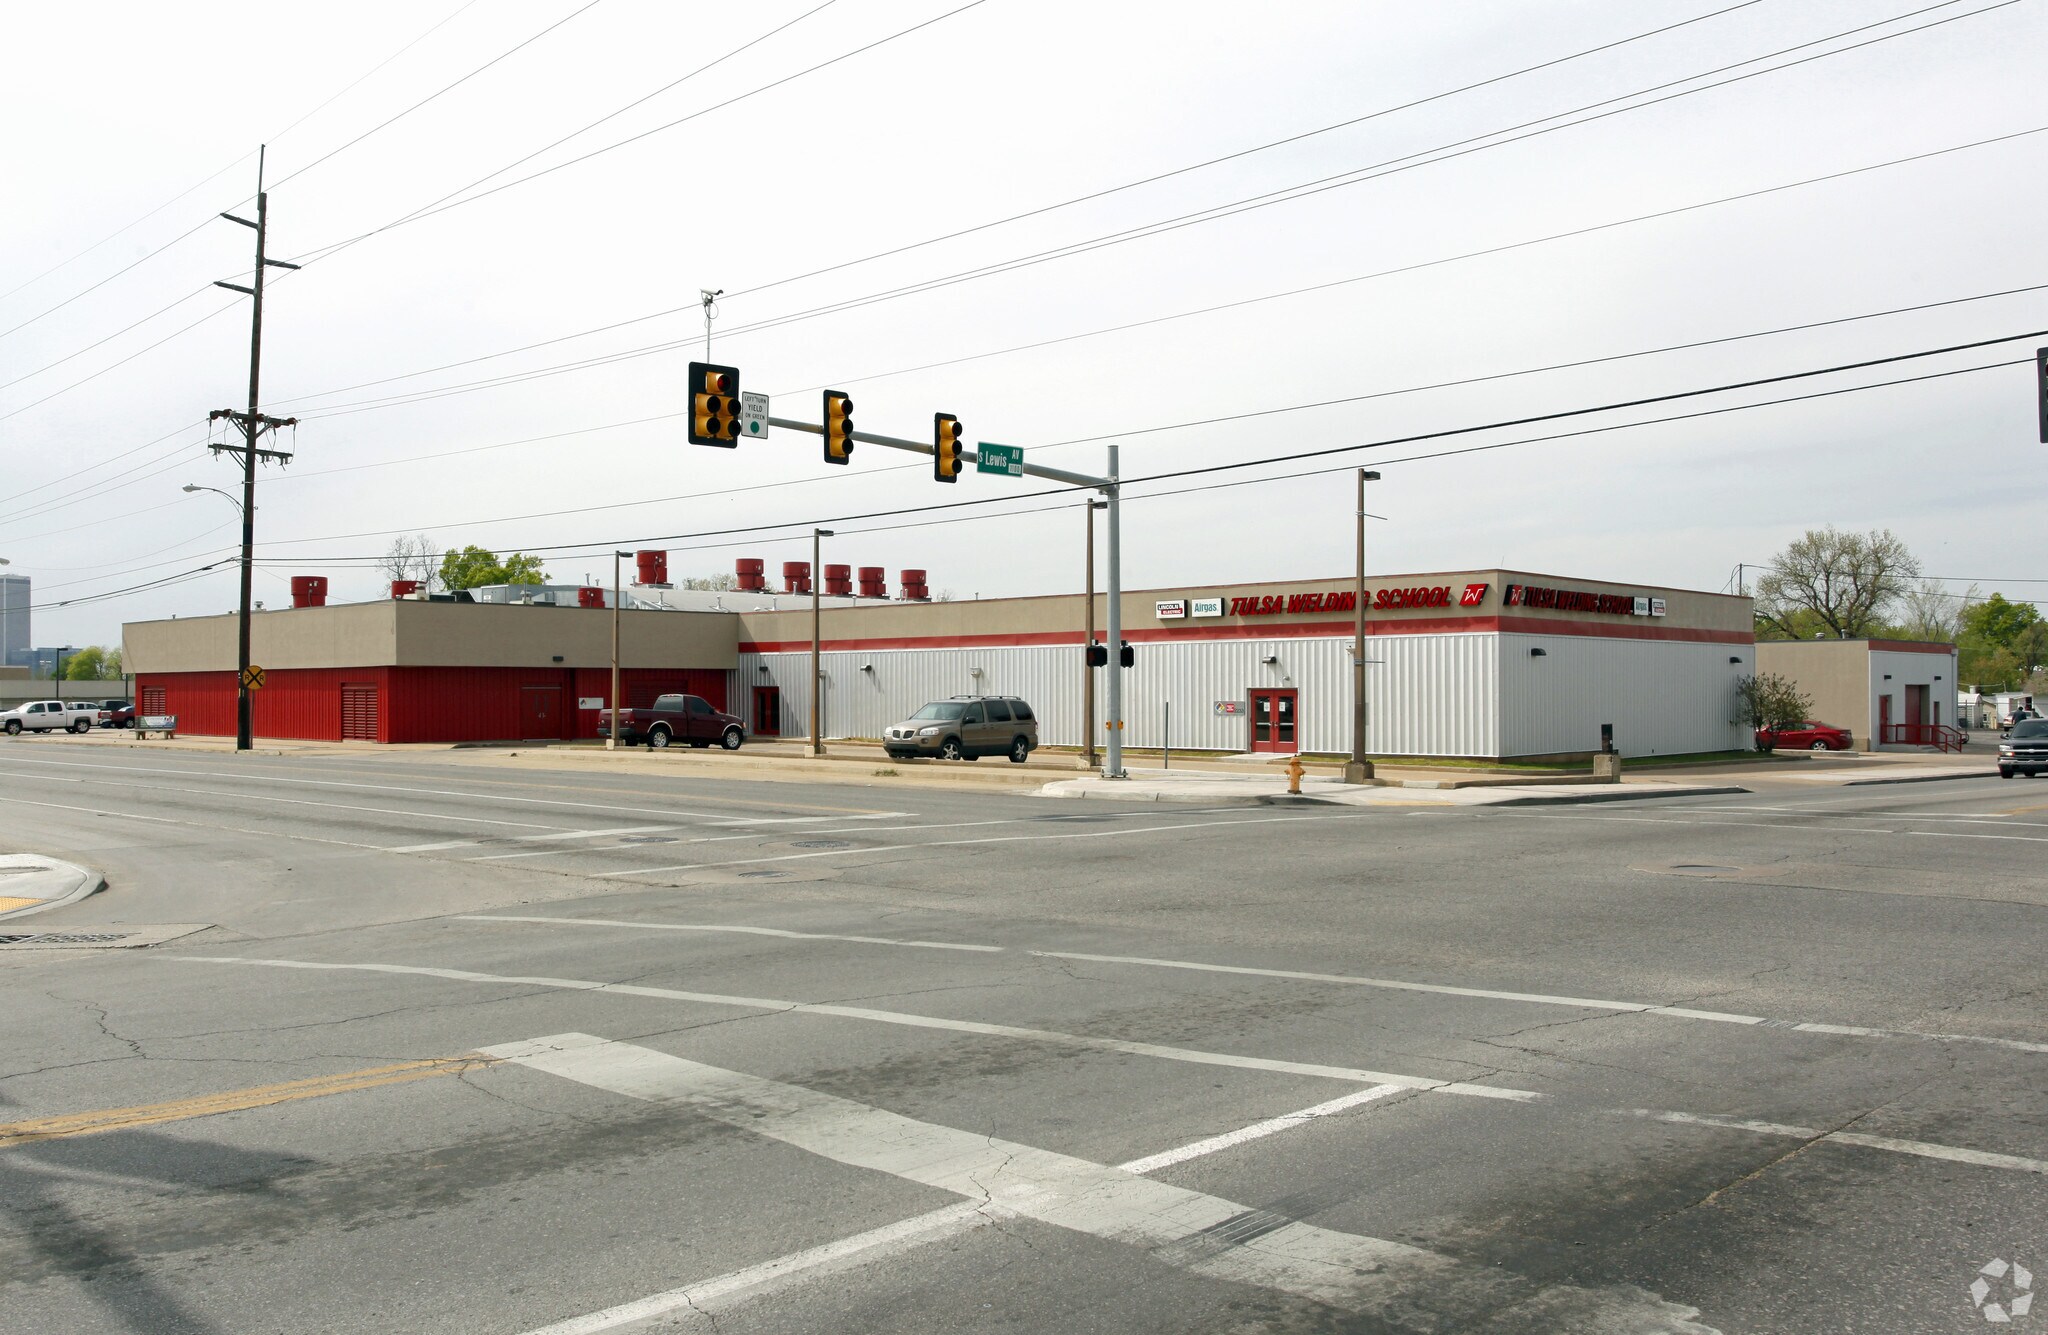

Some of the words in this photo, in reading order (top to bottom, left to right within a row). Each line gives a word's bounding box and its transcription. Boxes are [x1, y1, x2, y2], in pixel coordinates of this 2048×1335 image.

[748, 404, 762, 412] YIELD
[979, 452, 983, 462] S
[985, 451, 1007, 467] Lewis
[1012, 449, 1019, 460] AV
[1229, 595, 1284, 617] TULSA
[1373, 586, 1452, 610] SCHOOL
[1524, 586, 1556, 608] TULSA
[1194, 602, 1217, 612] Airgas
